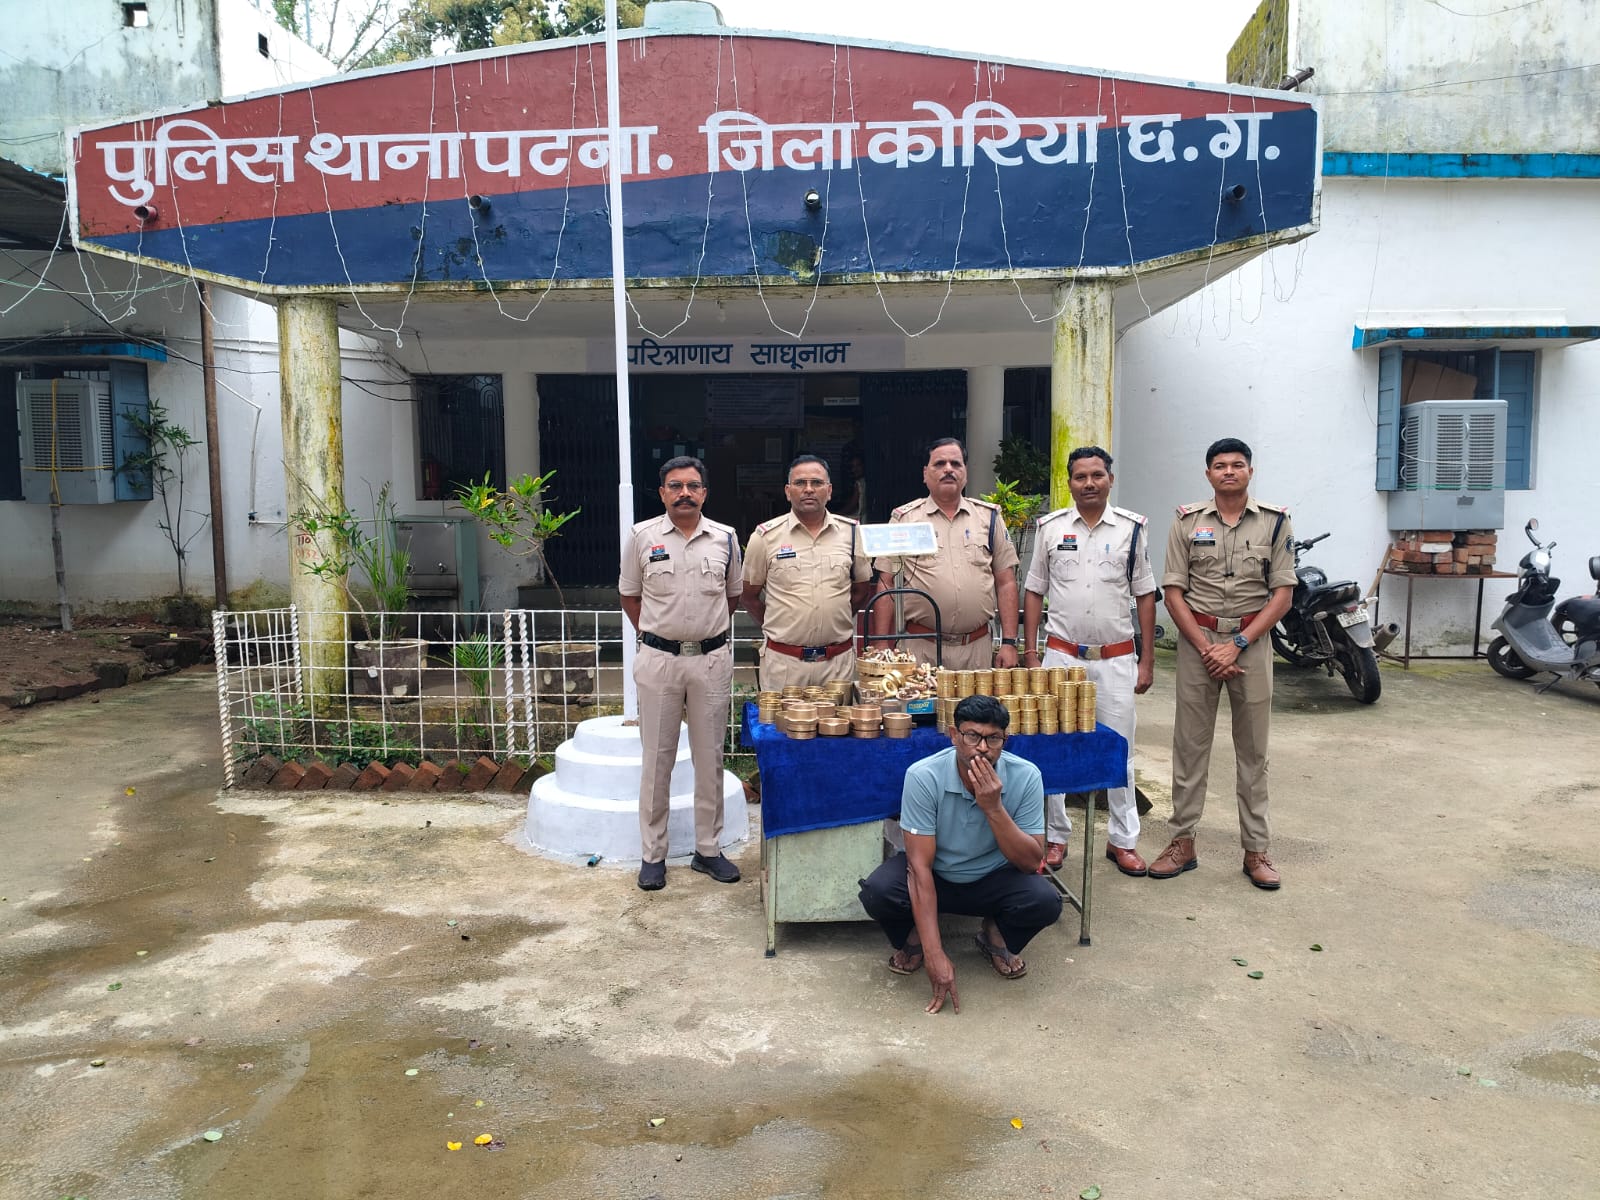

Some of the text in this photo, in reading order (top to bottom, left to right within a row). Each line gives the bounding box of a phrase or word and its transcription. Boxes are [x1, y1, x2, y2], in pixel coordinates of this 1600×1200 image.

[96, 119, 299, 206] पुलिस
[305, 132, 467, 181] थाना
[699, 110, 860, 173] जिला
[866, 101, 1107, 168] कोरिया
